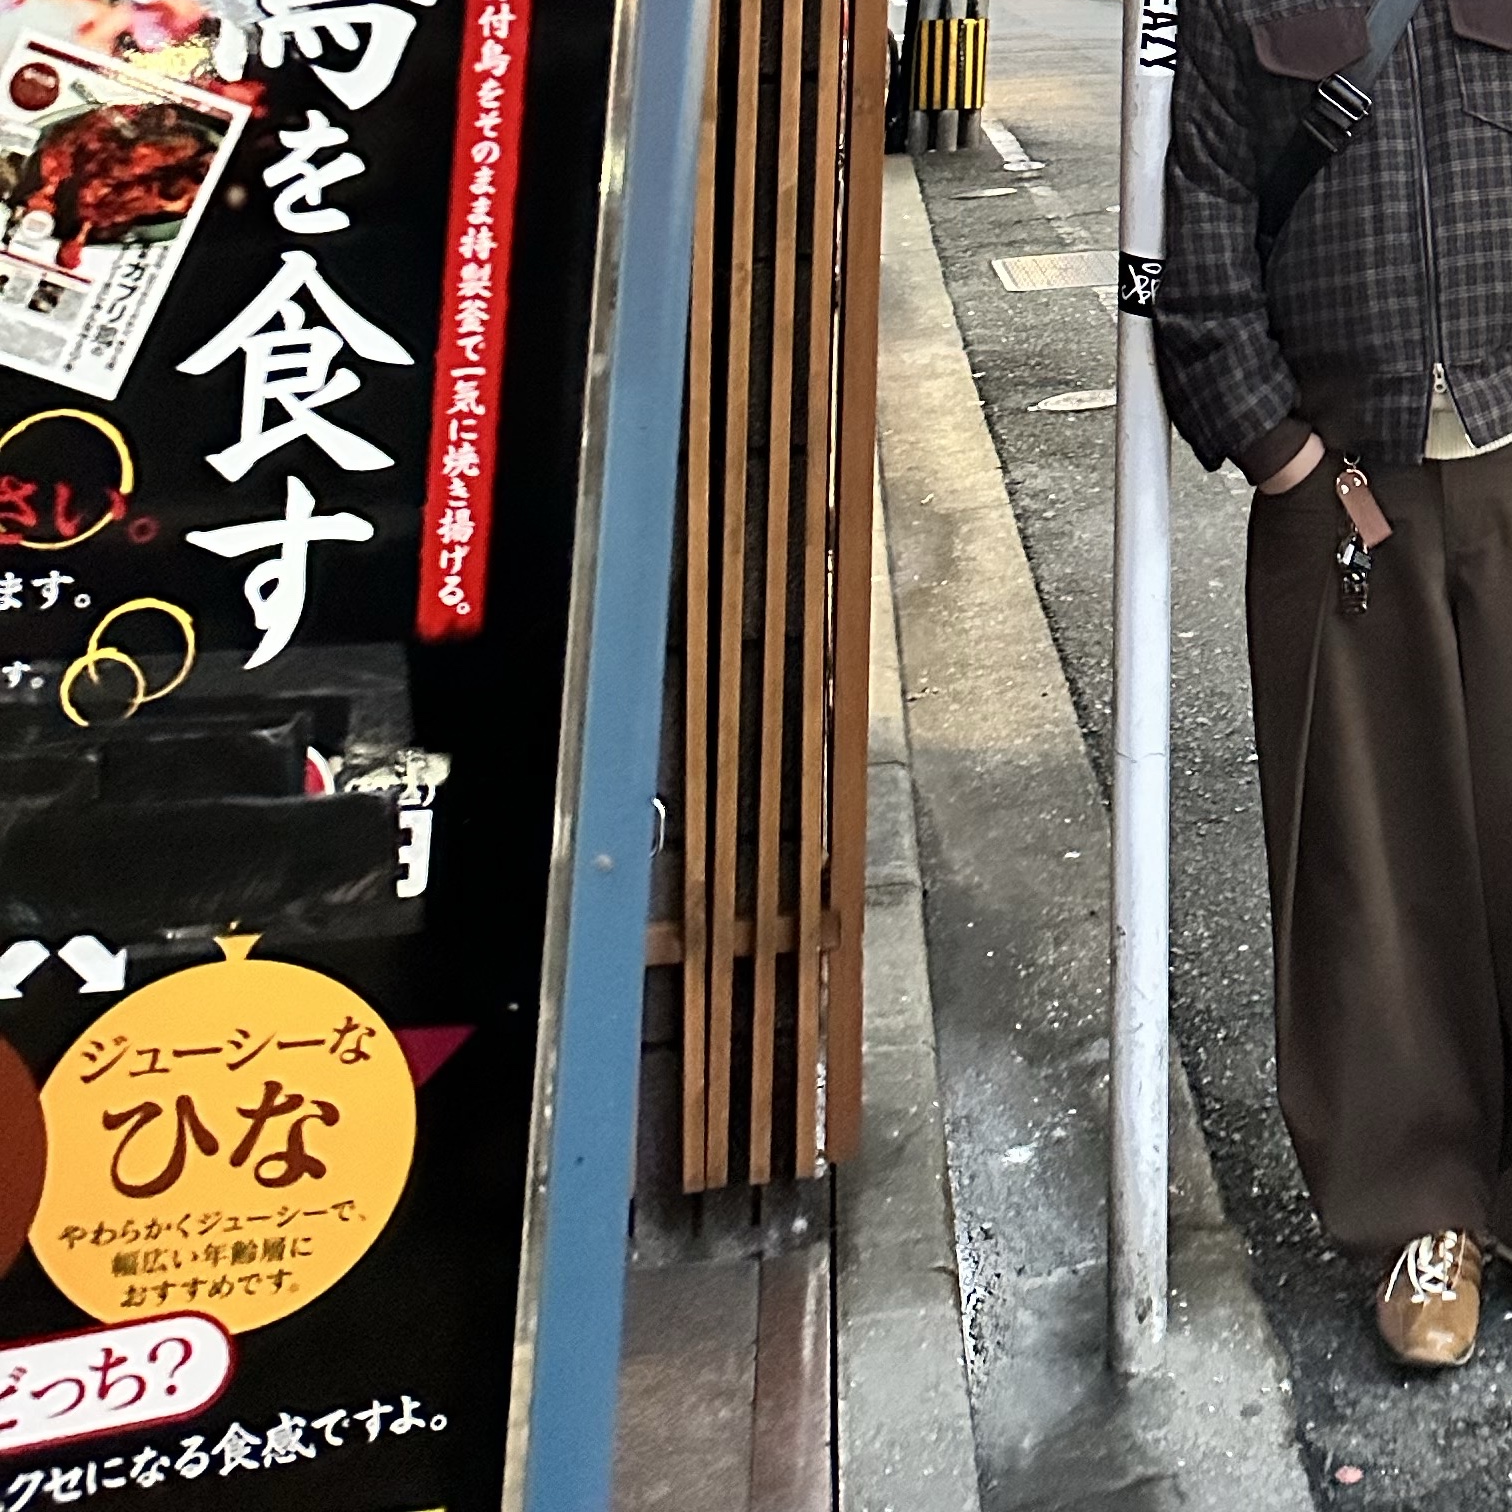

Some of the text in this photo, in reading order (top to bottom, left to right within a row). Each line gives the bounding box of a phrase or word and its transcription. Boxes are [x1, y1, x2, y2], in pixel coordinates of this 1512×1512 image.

[80, 1015, 377, 1085] ジューシーな
[102, 1080, 341, 1200] ひな
[58, 1199, 368, 1251] やわらかくジューシーで、
[120, 1268, 302, 1309] おすすめです。
[0, 1395, 449, 1512] クセになる食感ですよ。
